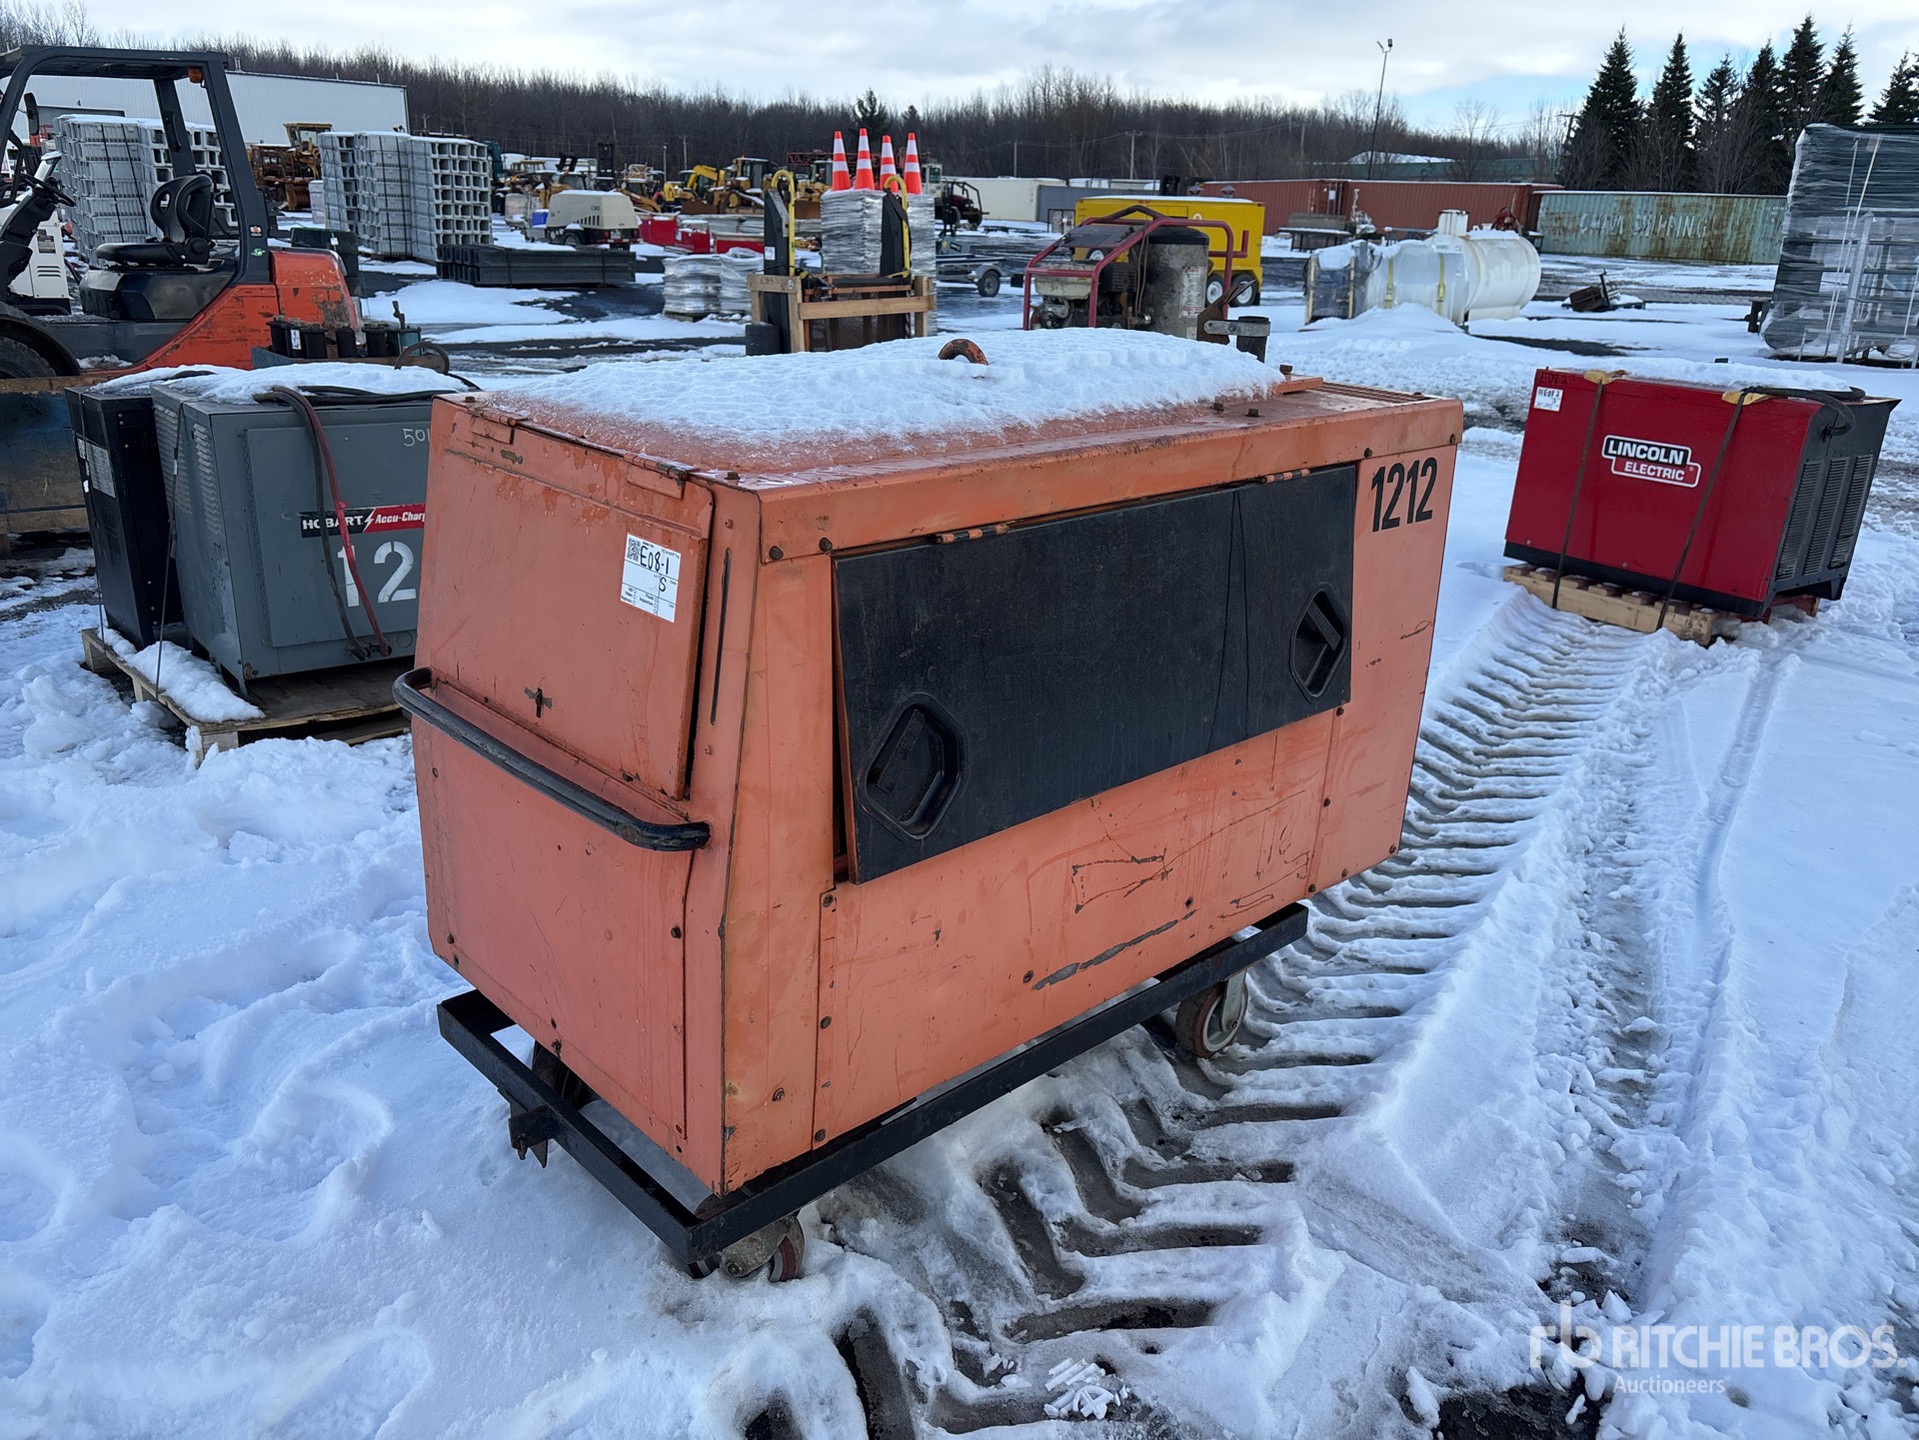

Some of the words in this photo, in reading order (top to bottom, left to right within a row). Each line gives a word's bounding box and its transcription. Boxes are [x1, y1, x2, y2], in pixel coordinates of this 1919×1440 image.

[1607, 439, 1684, 466] LINCOLN
[1624, 461, 1685, 481] ELECTRIC
[1370, 456, 1438, 533] 1212
[337, 540, 417, 608] 12
